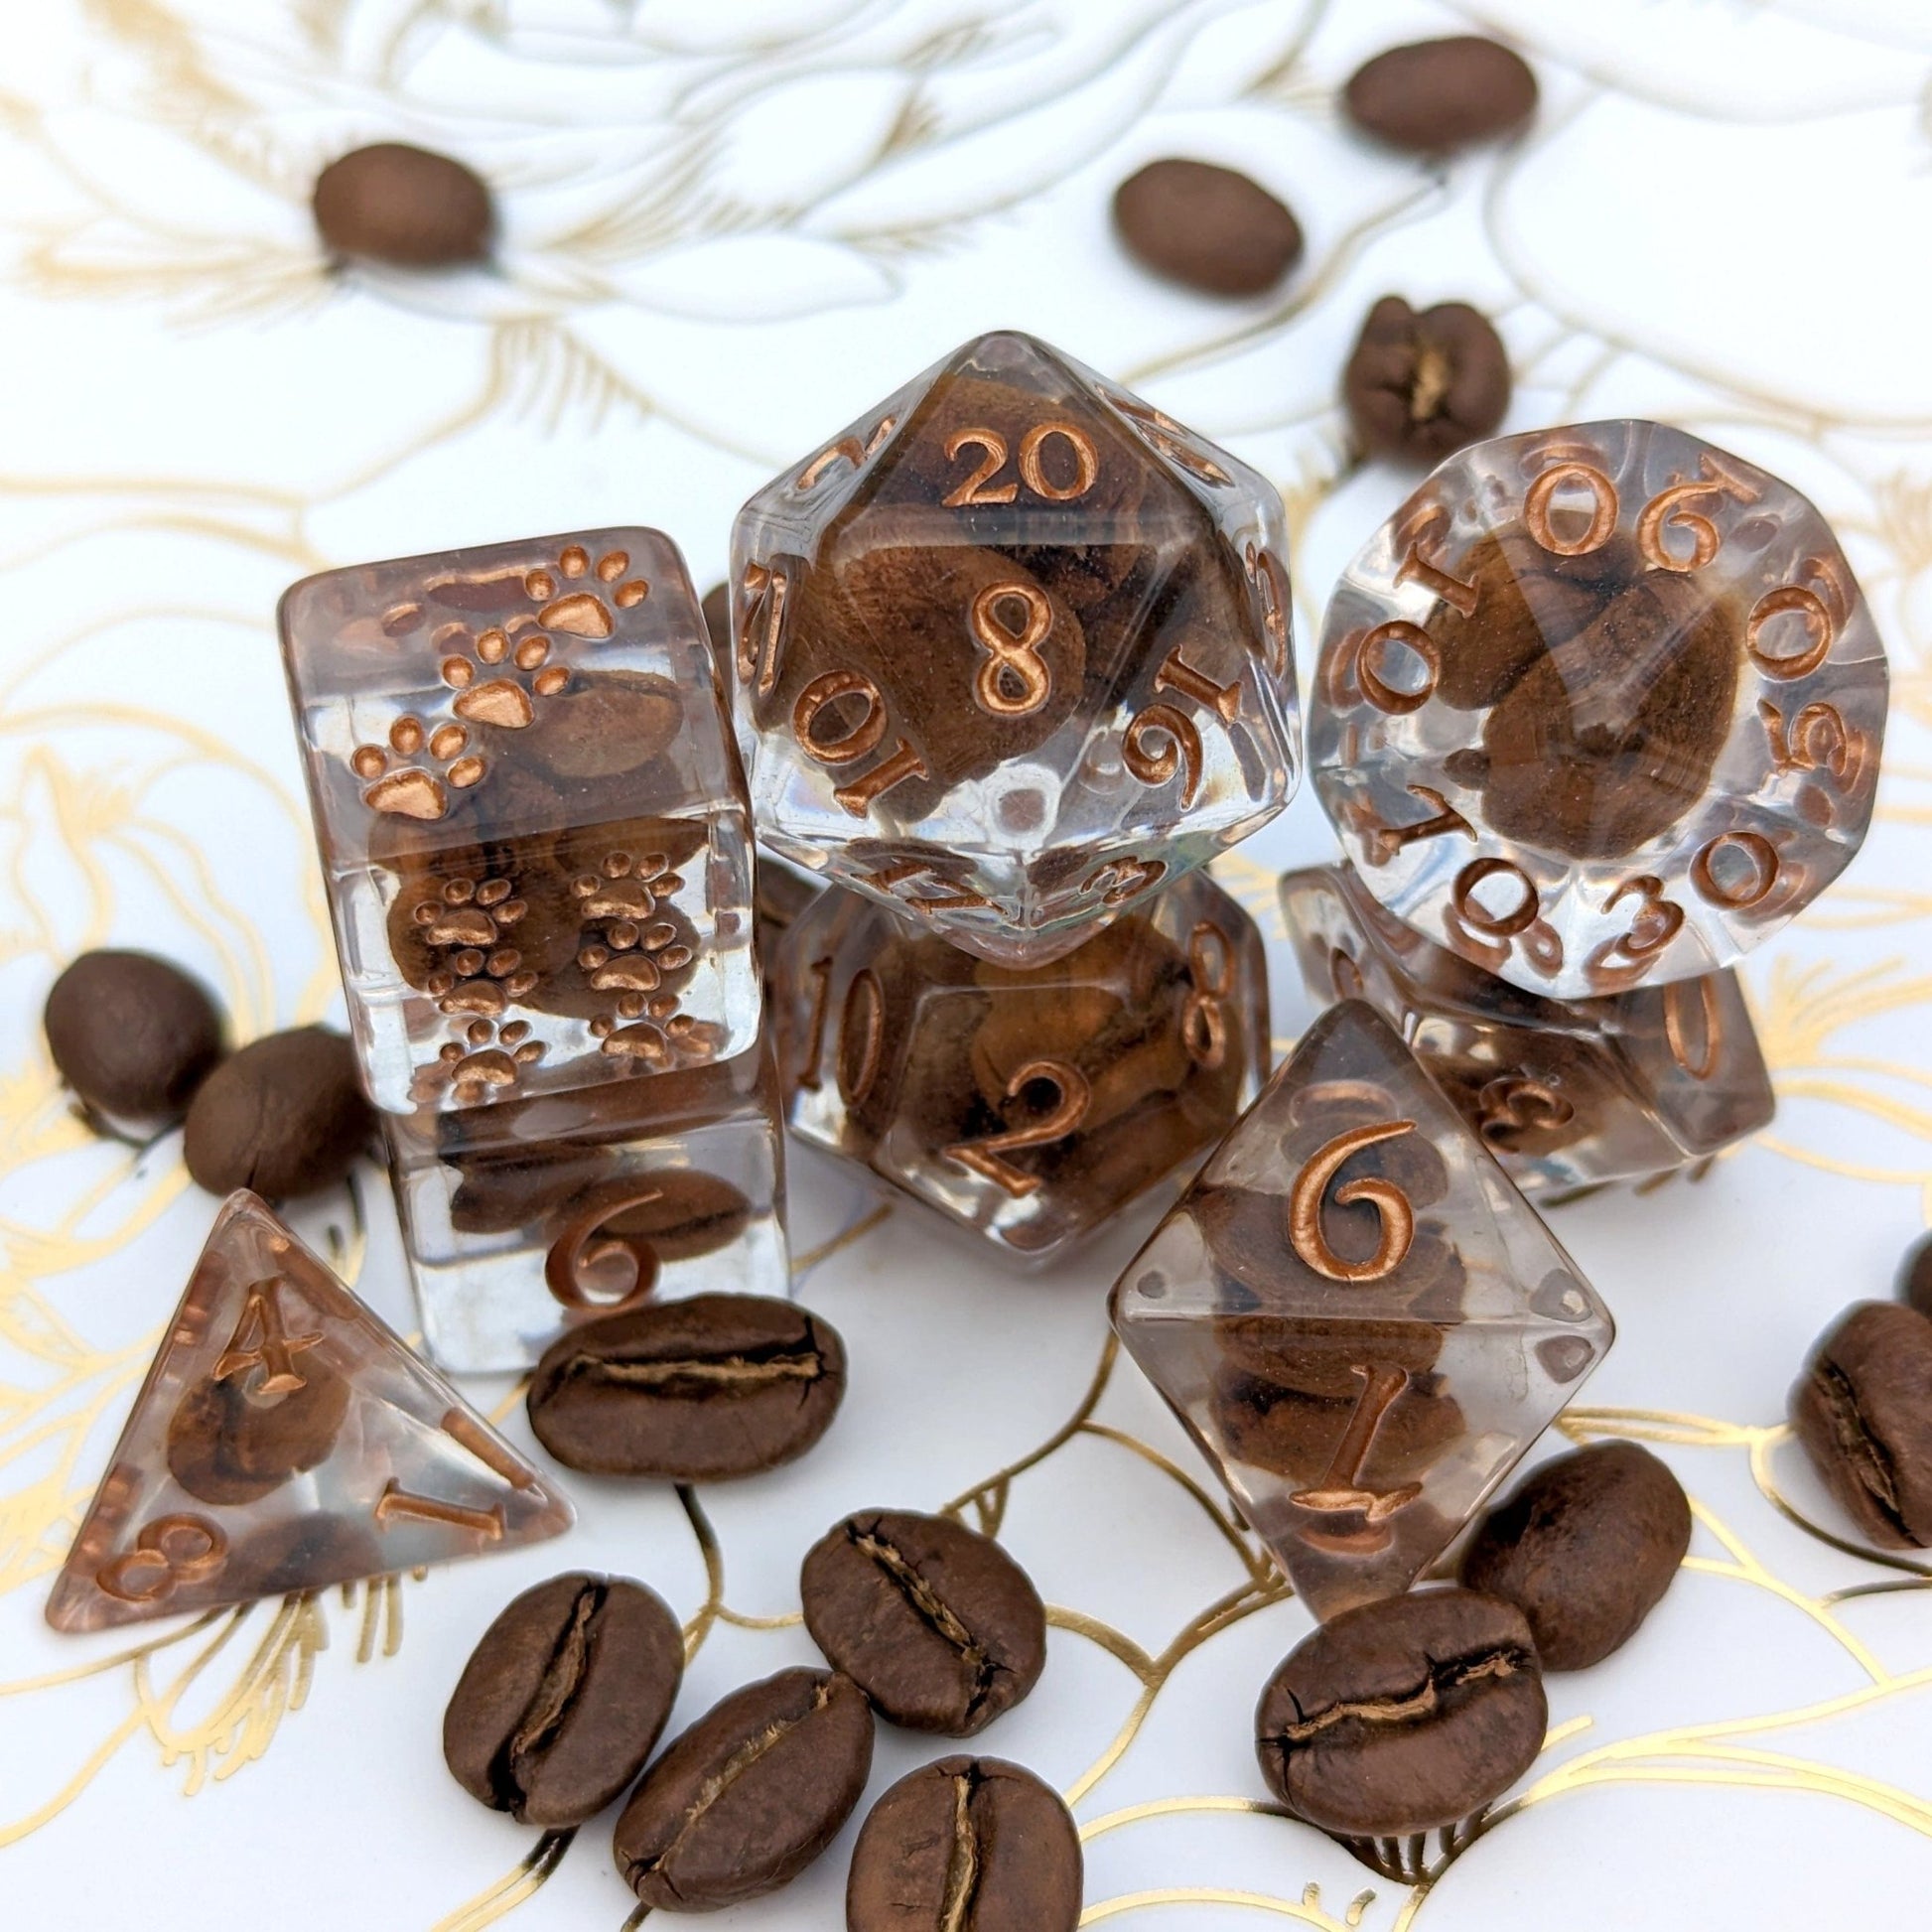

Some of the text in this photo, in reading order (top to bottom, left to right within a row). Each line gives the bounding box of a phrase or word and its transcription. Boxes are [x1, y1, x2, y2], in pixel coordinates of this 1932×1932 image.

[942, 422, 1099, 507] 20
[971, 580, 1054, 717] 8
[793, 669, 929, 820] 10
[1122, 644, 1243, 812] 16
[797, 955, 885, 1108] 10
[945, 1058, 1090, 1198] 2
[1289, 1118, 1419, 1283] 6
[546, 1190, 664, 1311] 6
